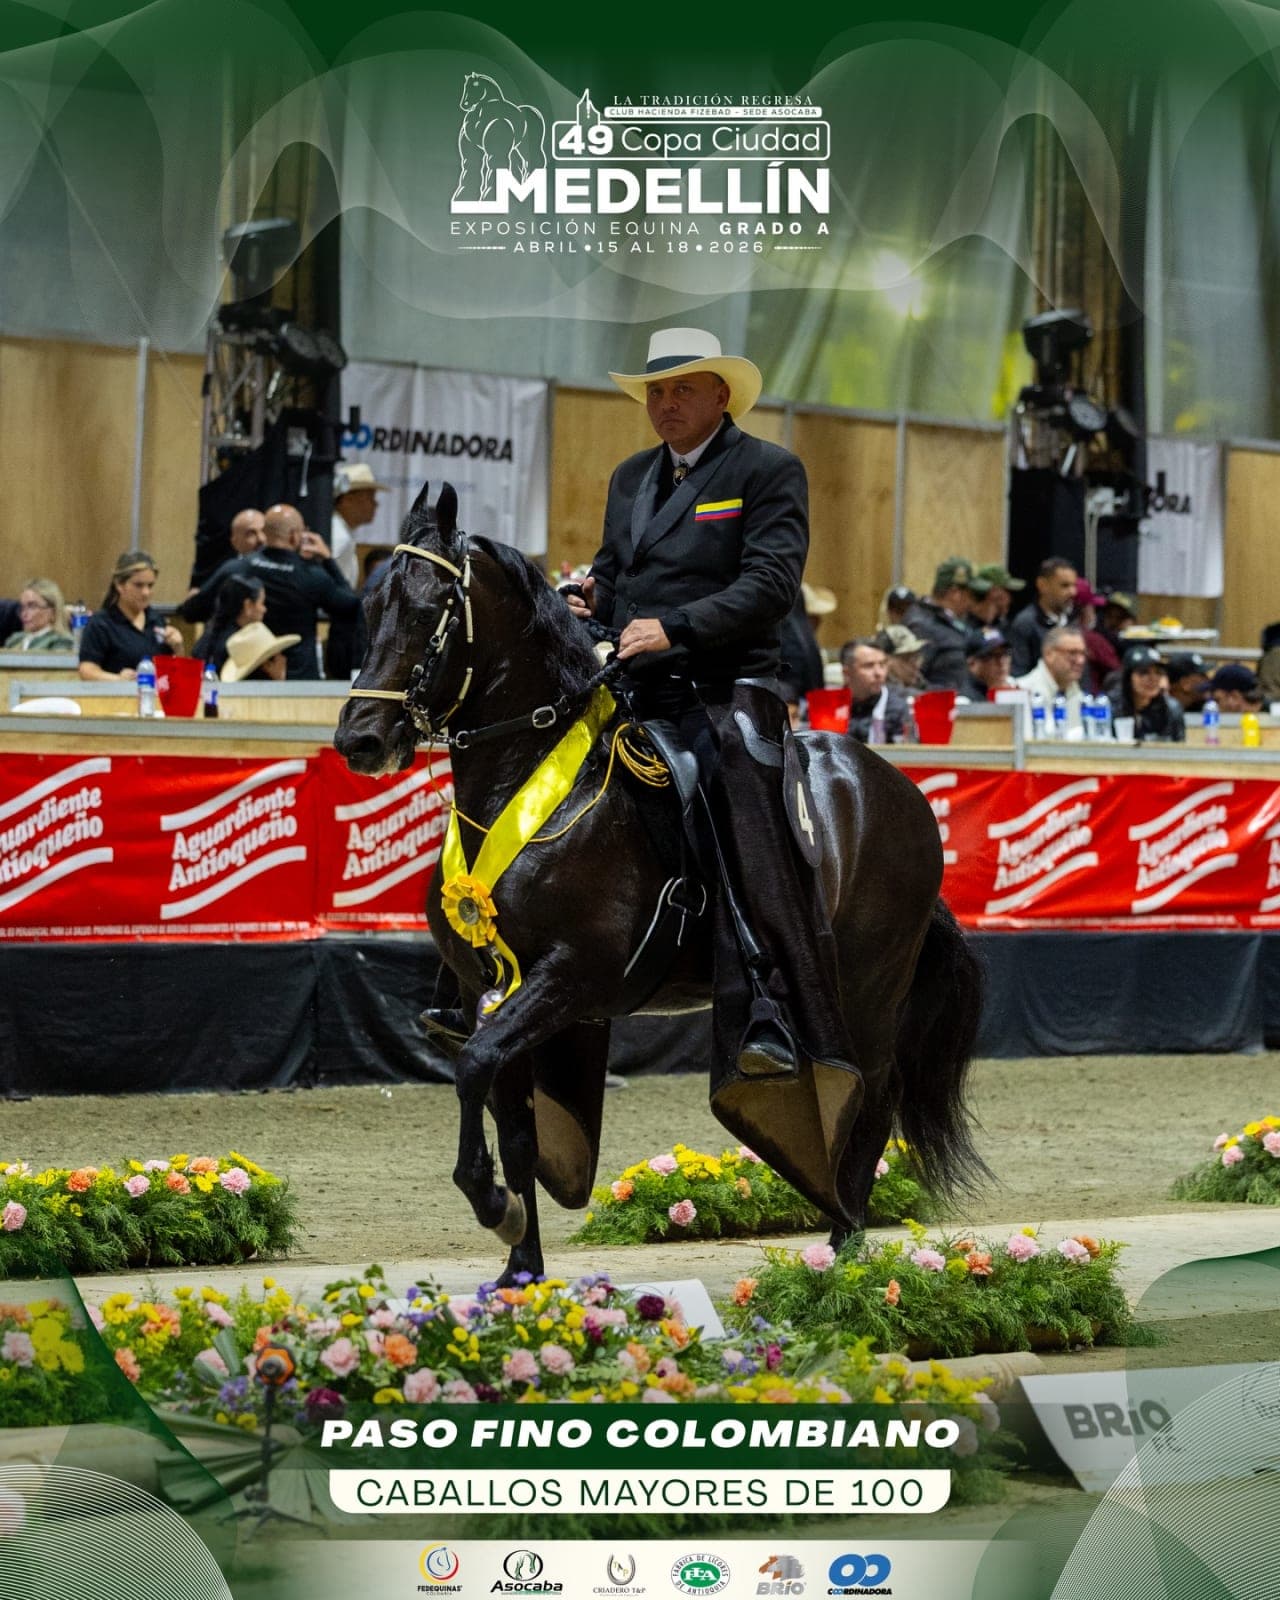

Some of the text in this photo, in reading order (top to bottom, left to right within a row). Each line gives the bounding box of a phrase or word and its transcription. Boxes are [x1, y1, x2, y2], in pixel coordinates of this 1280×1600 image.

[340, 423, 513, 463] ORDINADORA
[0, 787, 102, 854] uardiente
[0, 811, 104, 883] tioqueño
[172, 787, 297, 862] Aguardiente
[342, 813, 450, 881] Antioque
[346, 782, 455, 853] Aguardien
[797, 782, 815, 847] 4
[168, 810, 299, 892] Antioqueño
